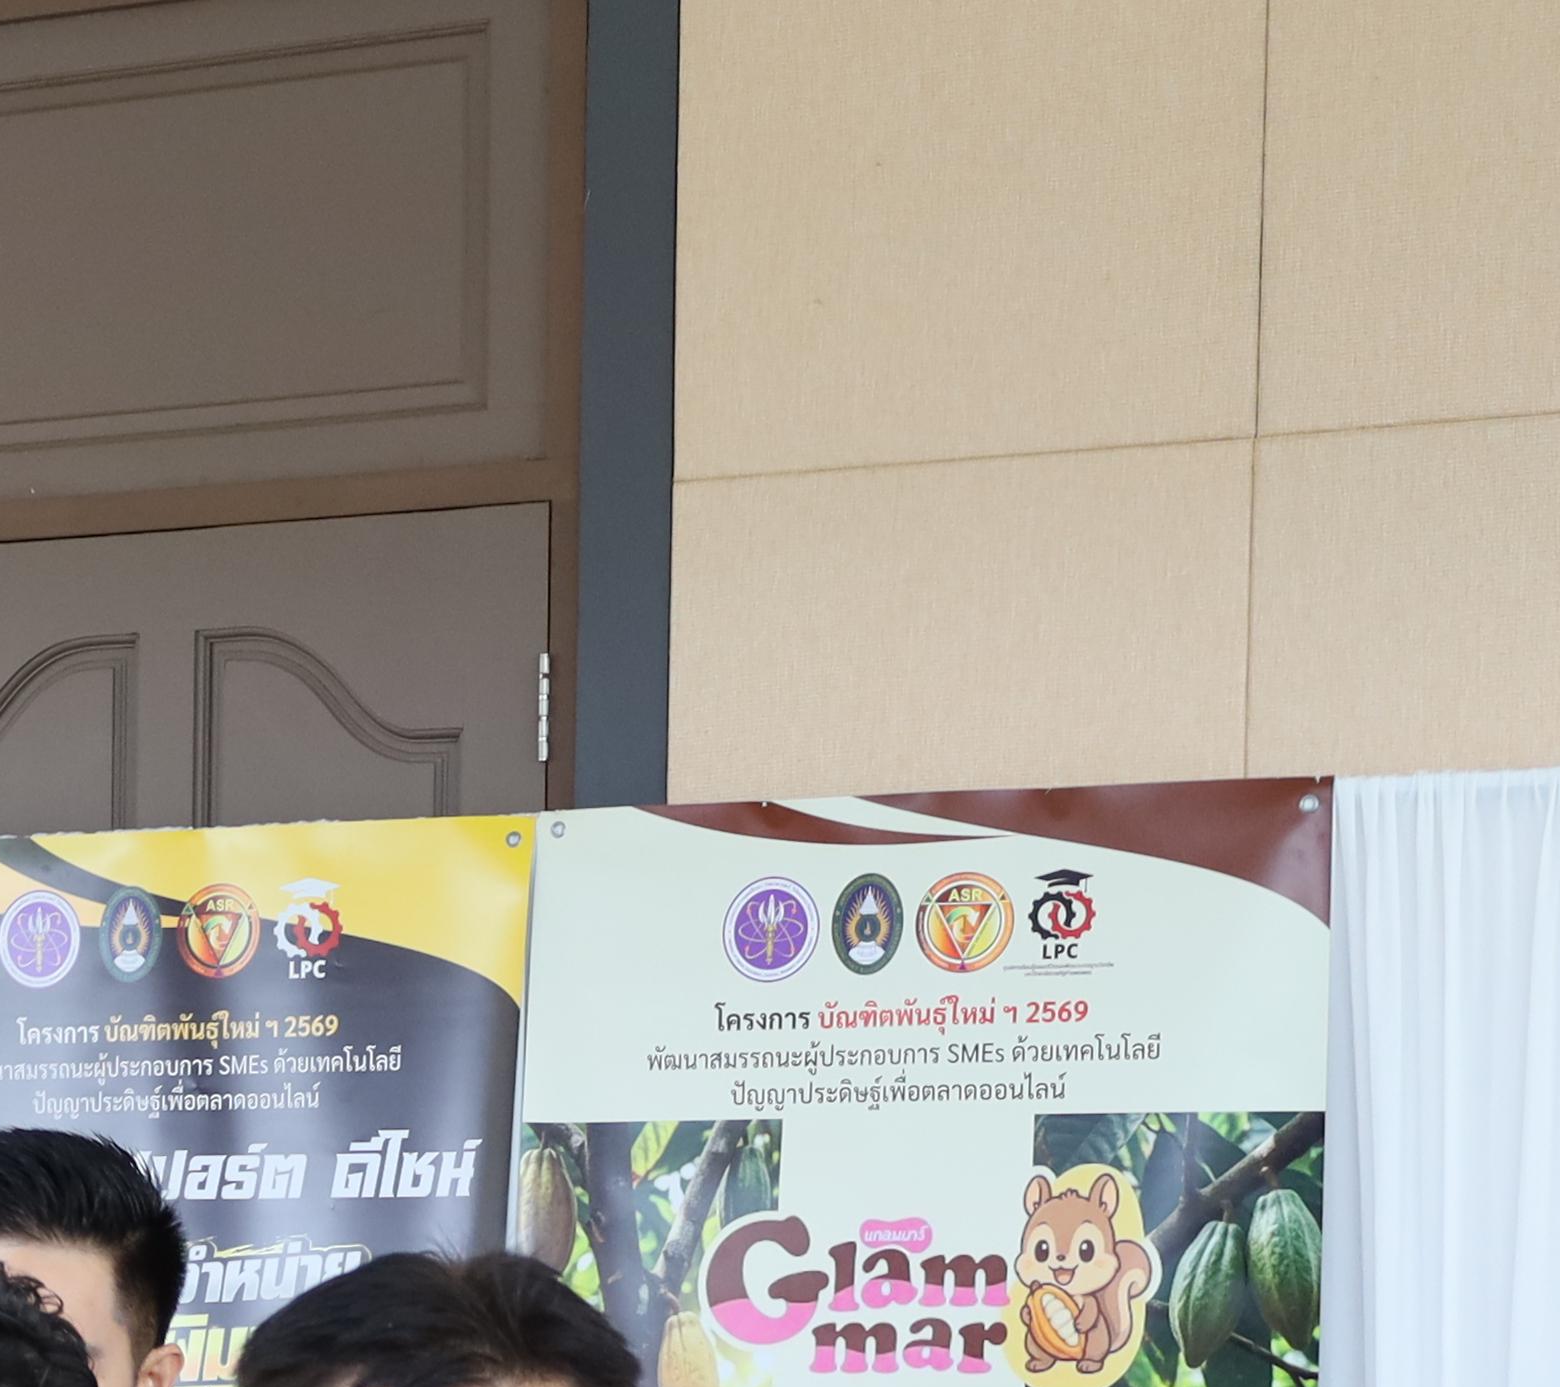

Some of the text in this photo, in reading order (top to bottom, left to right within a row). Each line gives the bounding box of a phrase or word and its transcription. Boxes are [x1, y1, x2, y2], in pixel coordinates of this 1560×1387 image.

[205, 899, 234, 912] ASR
[949, 887, 983, 902] ASR
[288, 959, 327, 980] LPC
[1041, 942, 1079, 960] LPC
[16, 1016, 99, 1046] โครงการ
[103, 1011, 260, 1050] บัณฑิตพันธุ์ใหม่
[283, 1014, 339, 1038] 2569
[714, 1001, 811, 1032] โครงการ
[817, 995, 996, 1035] บัณฑิตพันธุ์ใหม่
[1025, 999, 1089, 1024] 2569
[218, 1054, 269, 1076] SMEs
[273, 1044, 403, 1076] ด้วยเทคโนโลยี
[646, 1032, 1162, 1076] พัฒนาสมรรถนะผู้ประกอบการ SMEs ด้วยเทคโนโลยี
[32, 1080, 321, 1120] ปัญญาประดิษฐ์เพื่อตลาดออนไลน์
[730, 1070, 1067, 1112] ปัญญาประดิษฐ์เพื่อตลาดออนไลน์
[142, 1142, 309, 1201] ปอร์ต
[706, 1215, 1010, 1345] Glam
[809, 1318, 1008, 1374] mar
